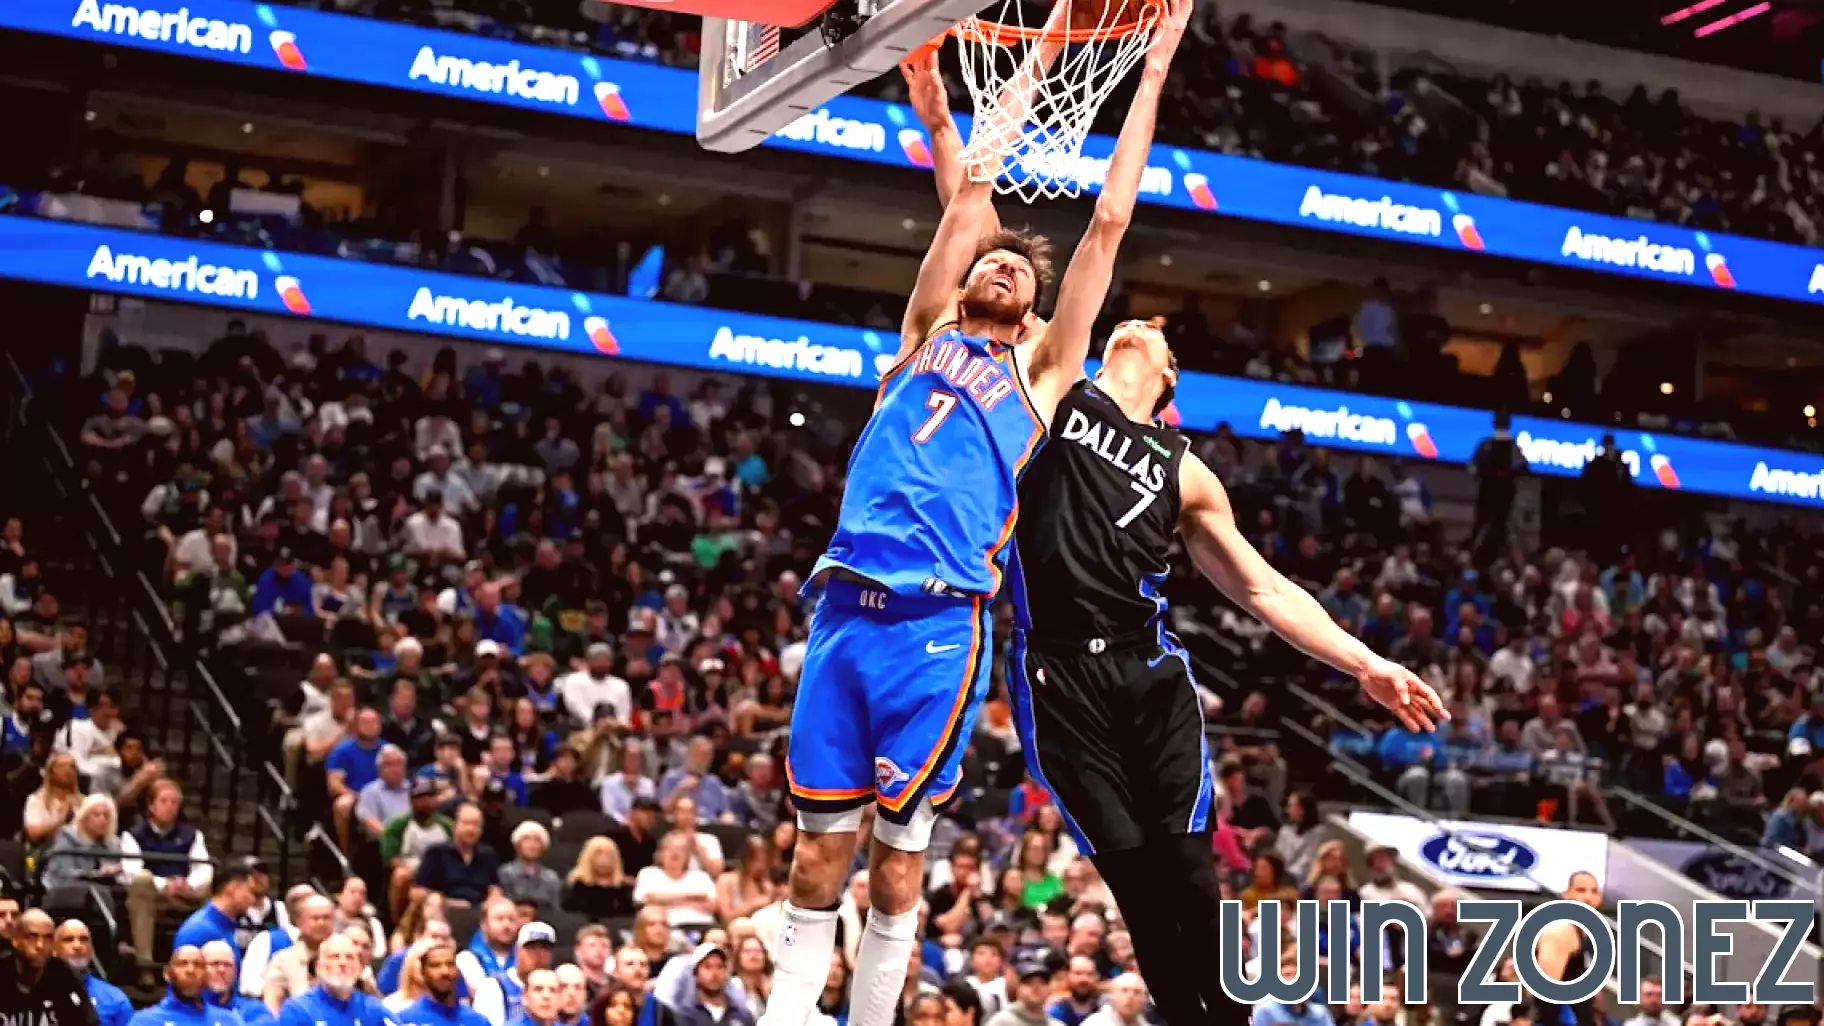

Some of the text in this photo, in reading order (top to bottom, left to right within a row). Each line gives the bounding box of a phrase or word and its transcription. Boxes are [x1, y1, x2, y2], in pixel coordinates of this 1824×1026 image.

[71, 0, 252, 54] American
[409, 46, 579, 105] American
[1300, 185, 1441, 236] American
[87, 245, 258, 299] American
[1562, 226, 1695, 275] American
[408, 287, 570, 340] American
[709, 327, 863, 377] American
[911, 388, 959, 443] 7
[1260, 398, 1396, 445] American
[1060, 407, 1166, 491] DALLAS
[1115, 481, 1157, 528] 7
[859, 588, 888, 610] OKC
